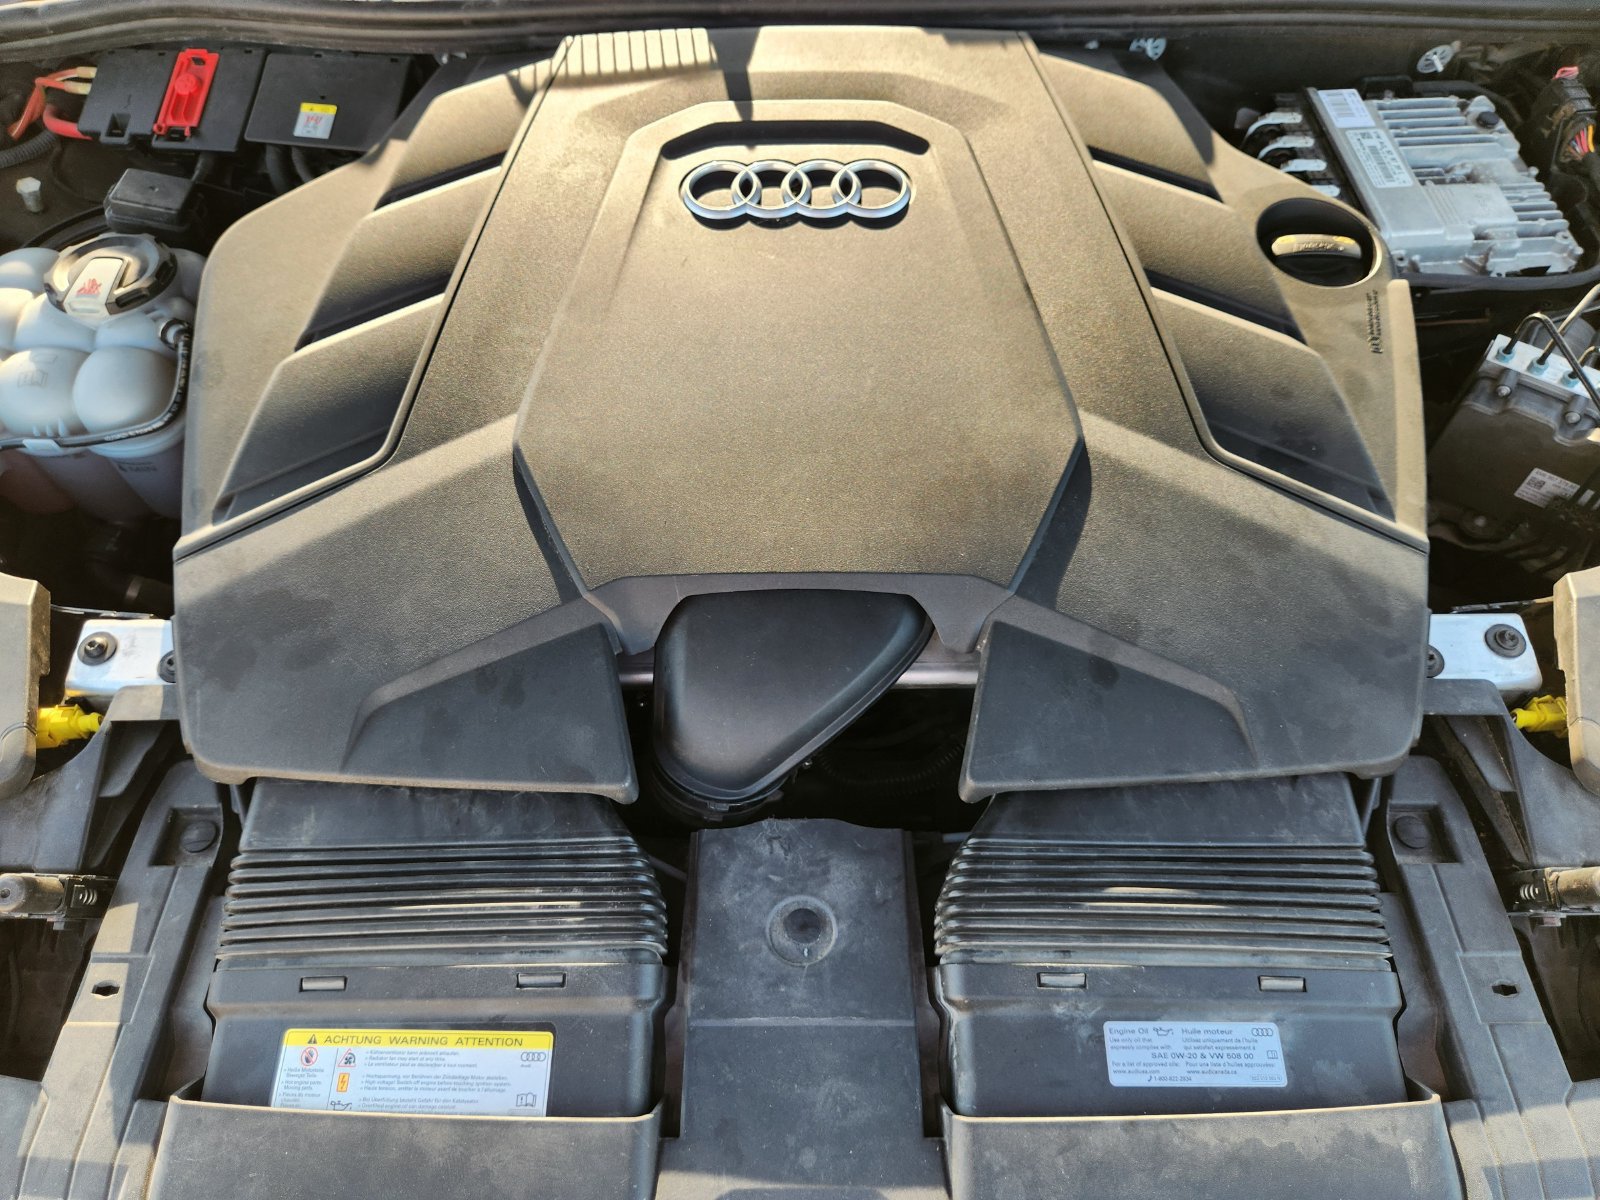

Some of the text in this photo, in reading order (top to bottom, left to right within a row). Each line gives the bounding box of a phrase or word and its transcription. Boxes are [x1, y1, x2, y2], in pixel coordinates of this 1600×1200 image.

[1109, 1027, 1136, 1035] Engine
[323, 1035, 523, 1047] ACHTUNG WARNING ATTENTION
